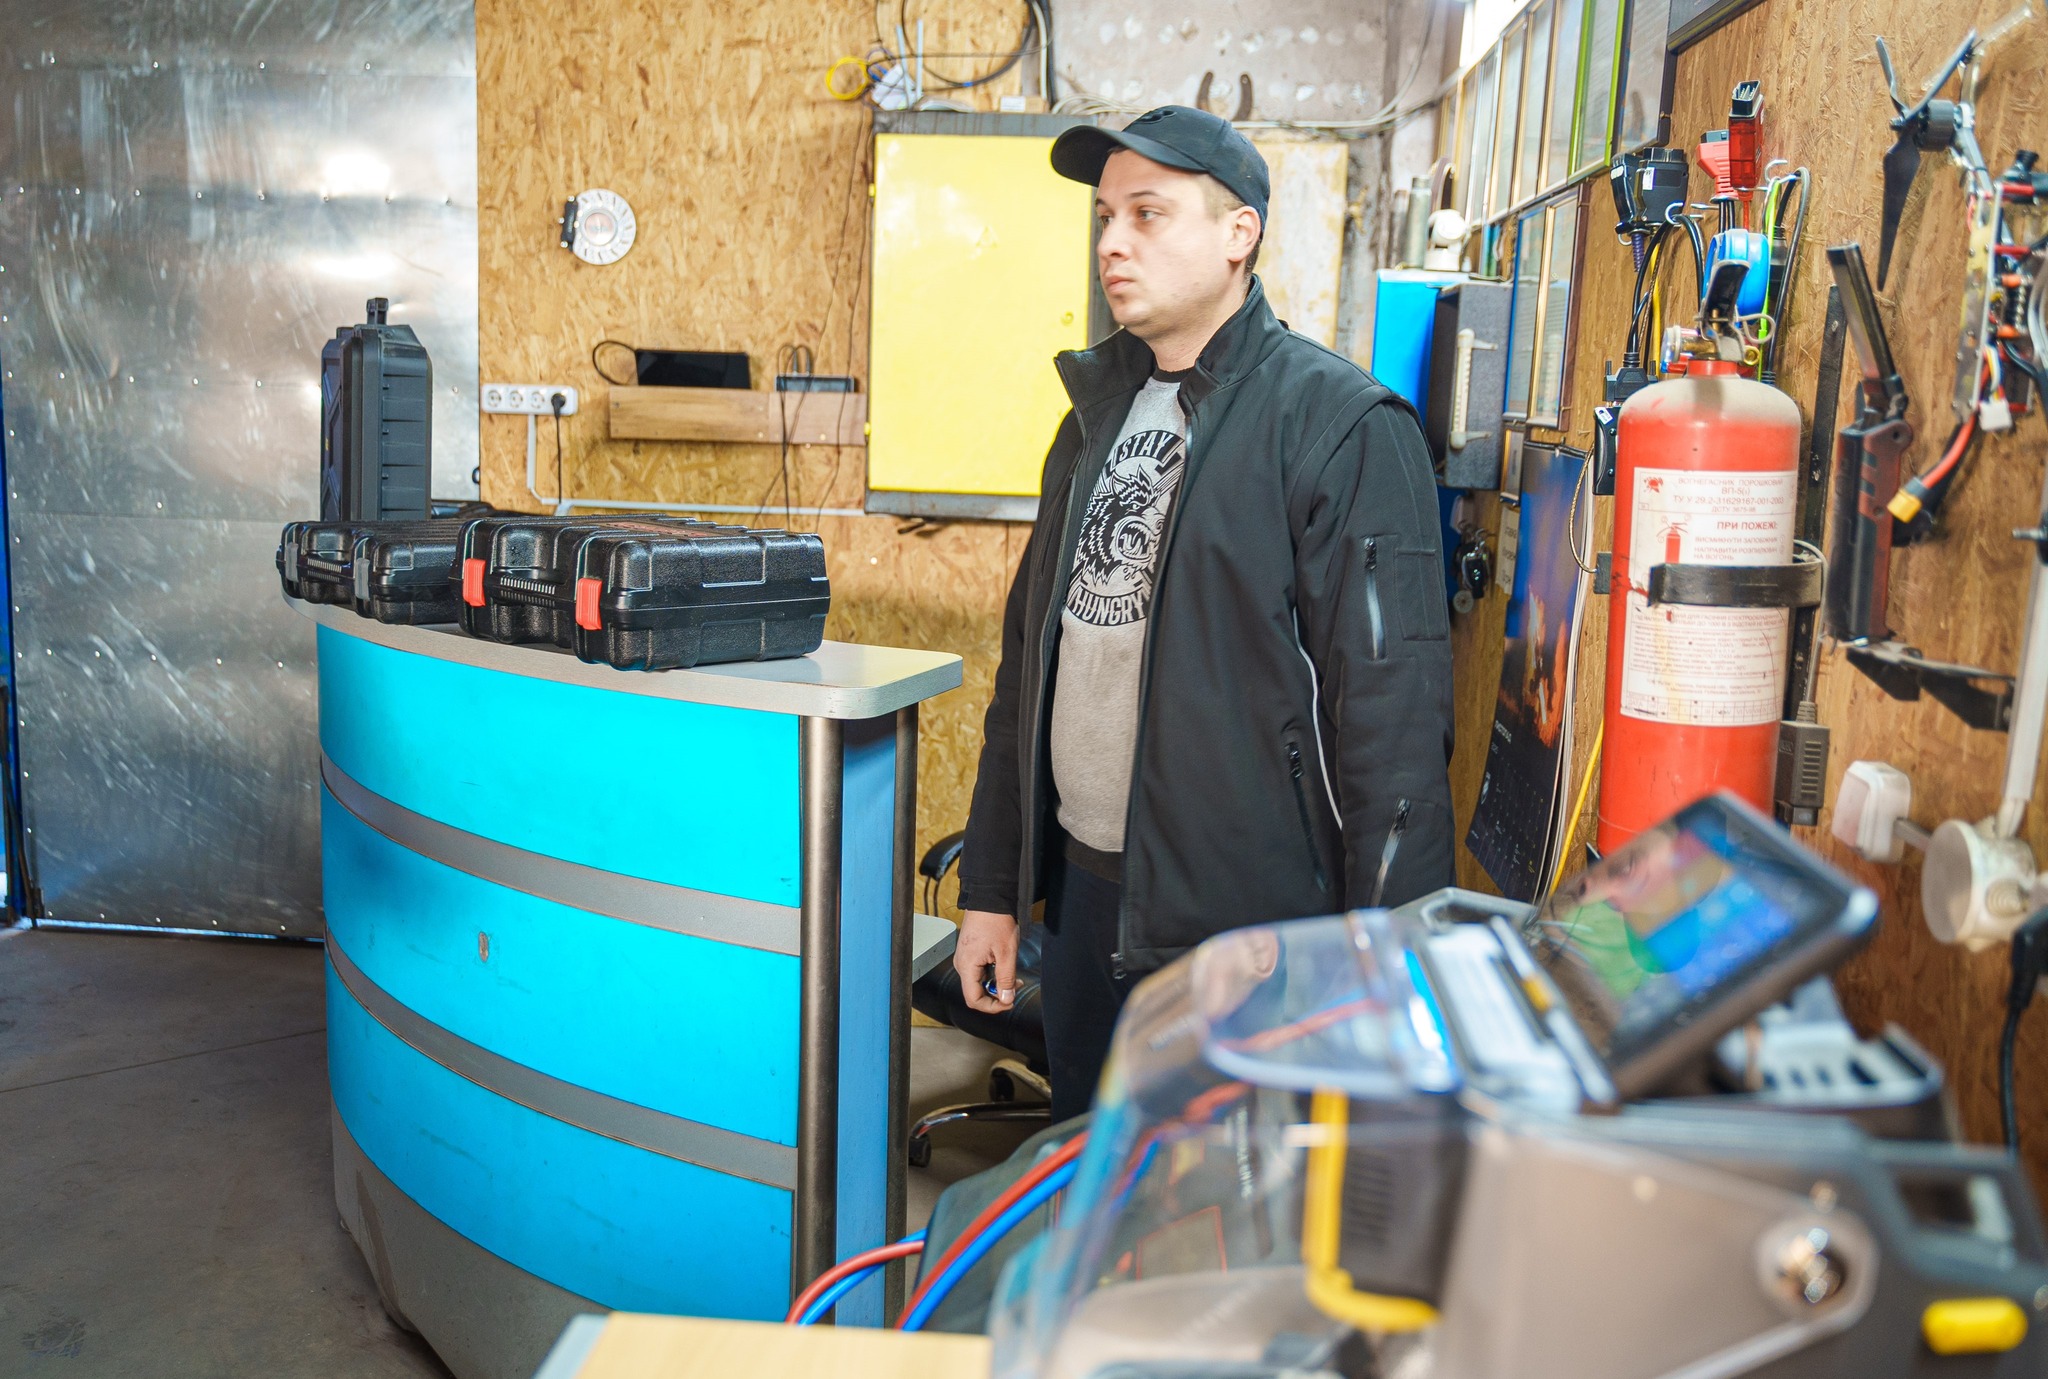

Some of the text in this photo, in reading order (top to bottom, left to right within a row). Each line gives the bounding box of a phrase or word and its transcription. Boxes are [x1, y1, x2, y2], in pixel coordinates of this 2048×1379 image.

[1119, 431, 1174, 461] STAY
[1717, 521, 1739, 530] ПРИ
[1072, 588, 1145, 625] HUNGRY
